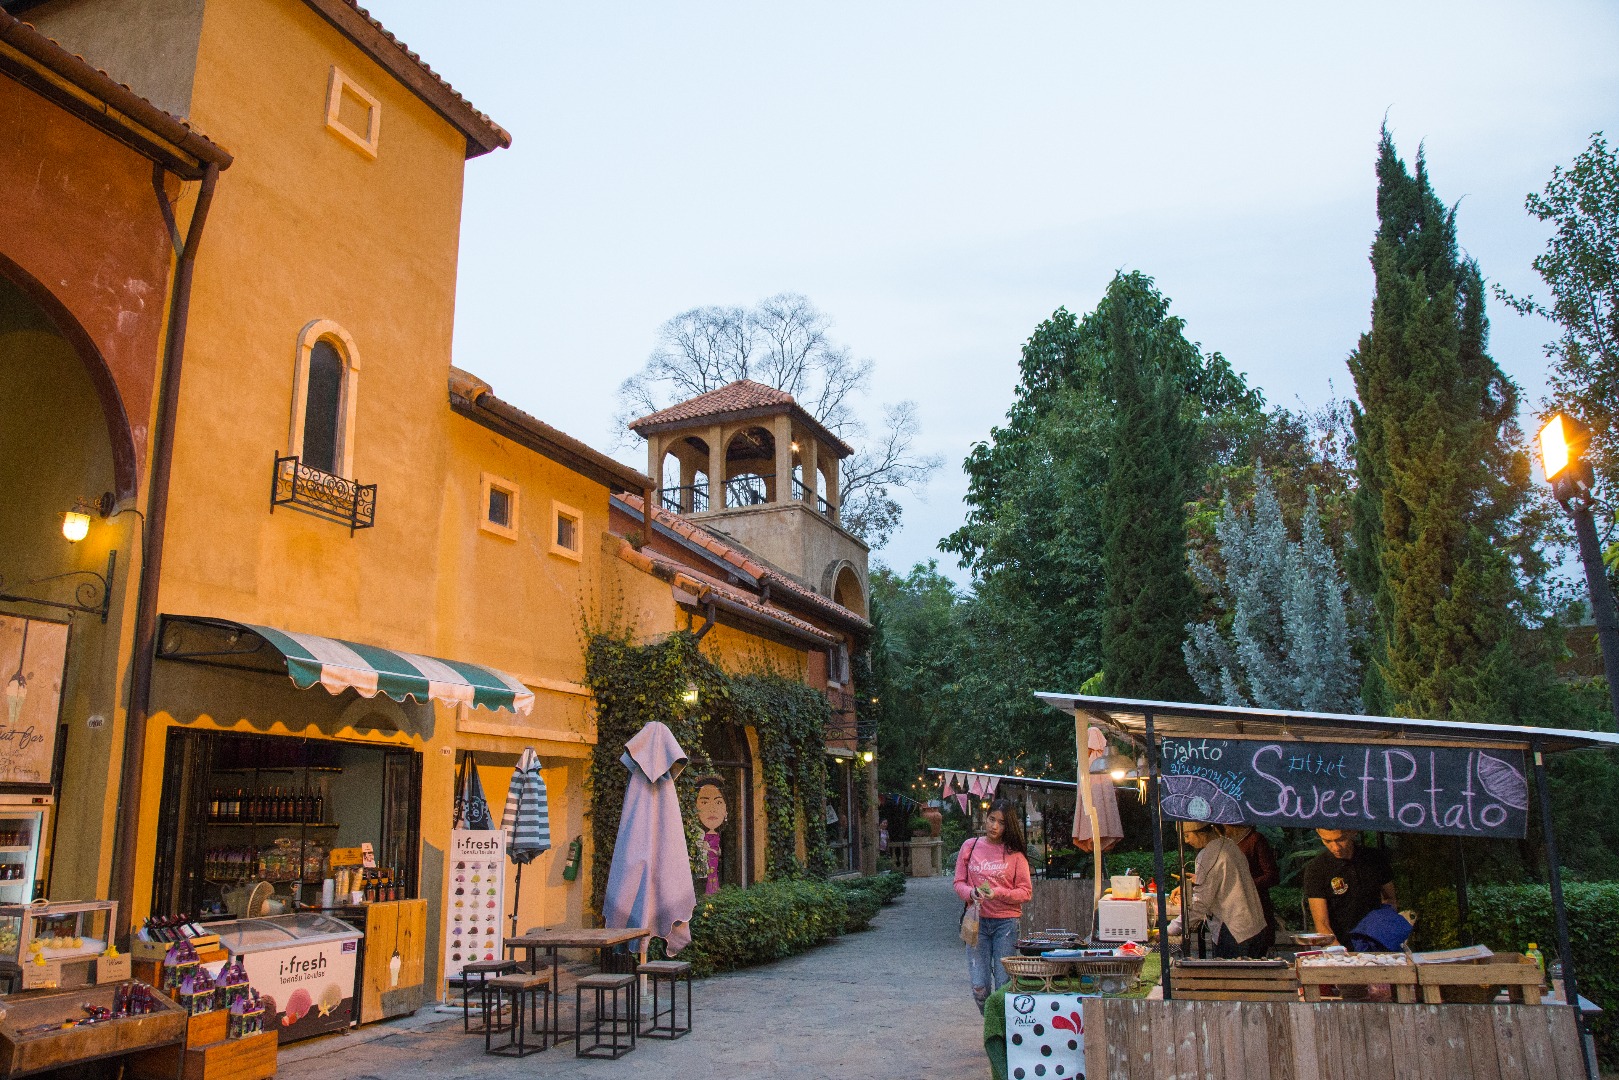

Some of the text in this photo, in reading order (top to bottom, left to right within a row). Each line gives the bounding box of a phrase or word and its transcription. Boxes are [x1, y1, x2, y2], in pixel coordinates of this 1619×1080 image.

[19, 725, 44, 750] Bar
[1245, 744, 1508, 831] Sweet Potato
